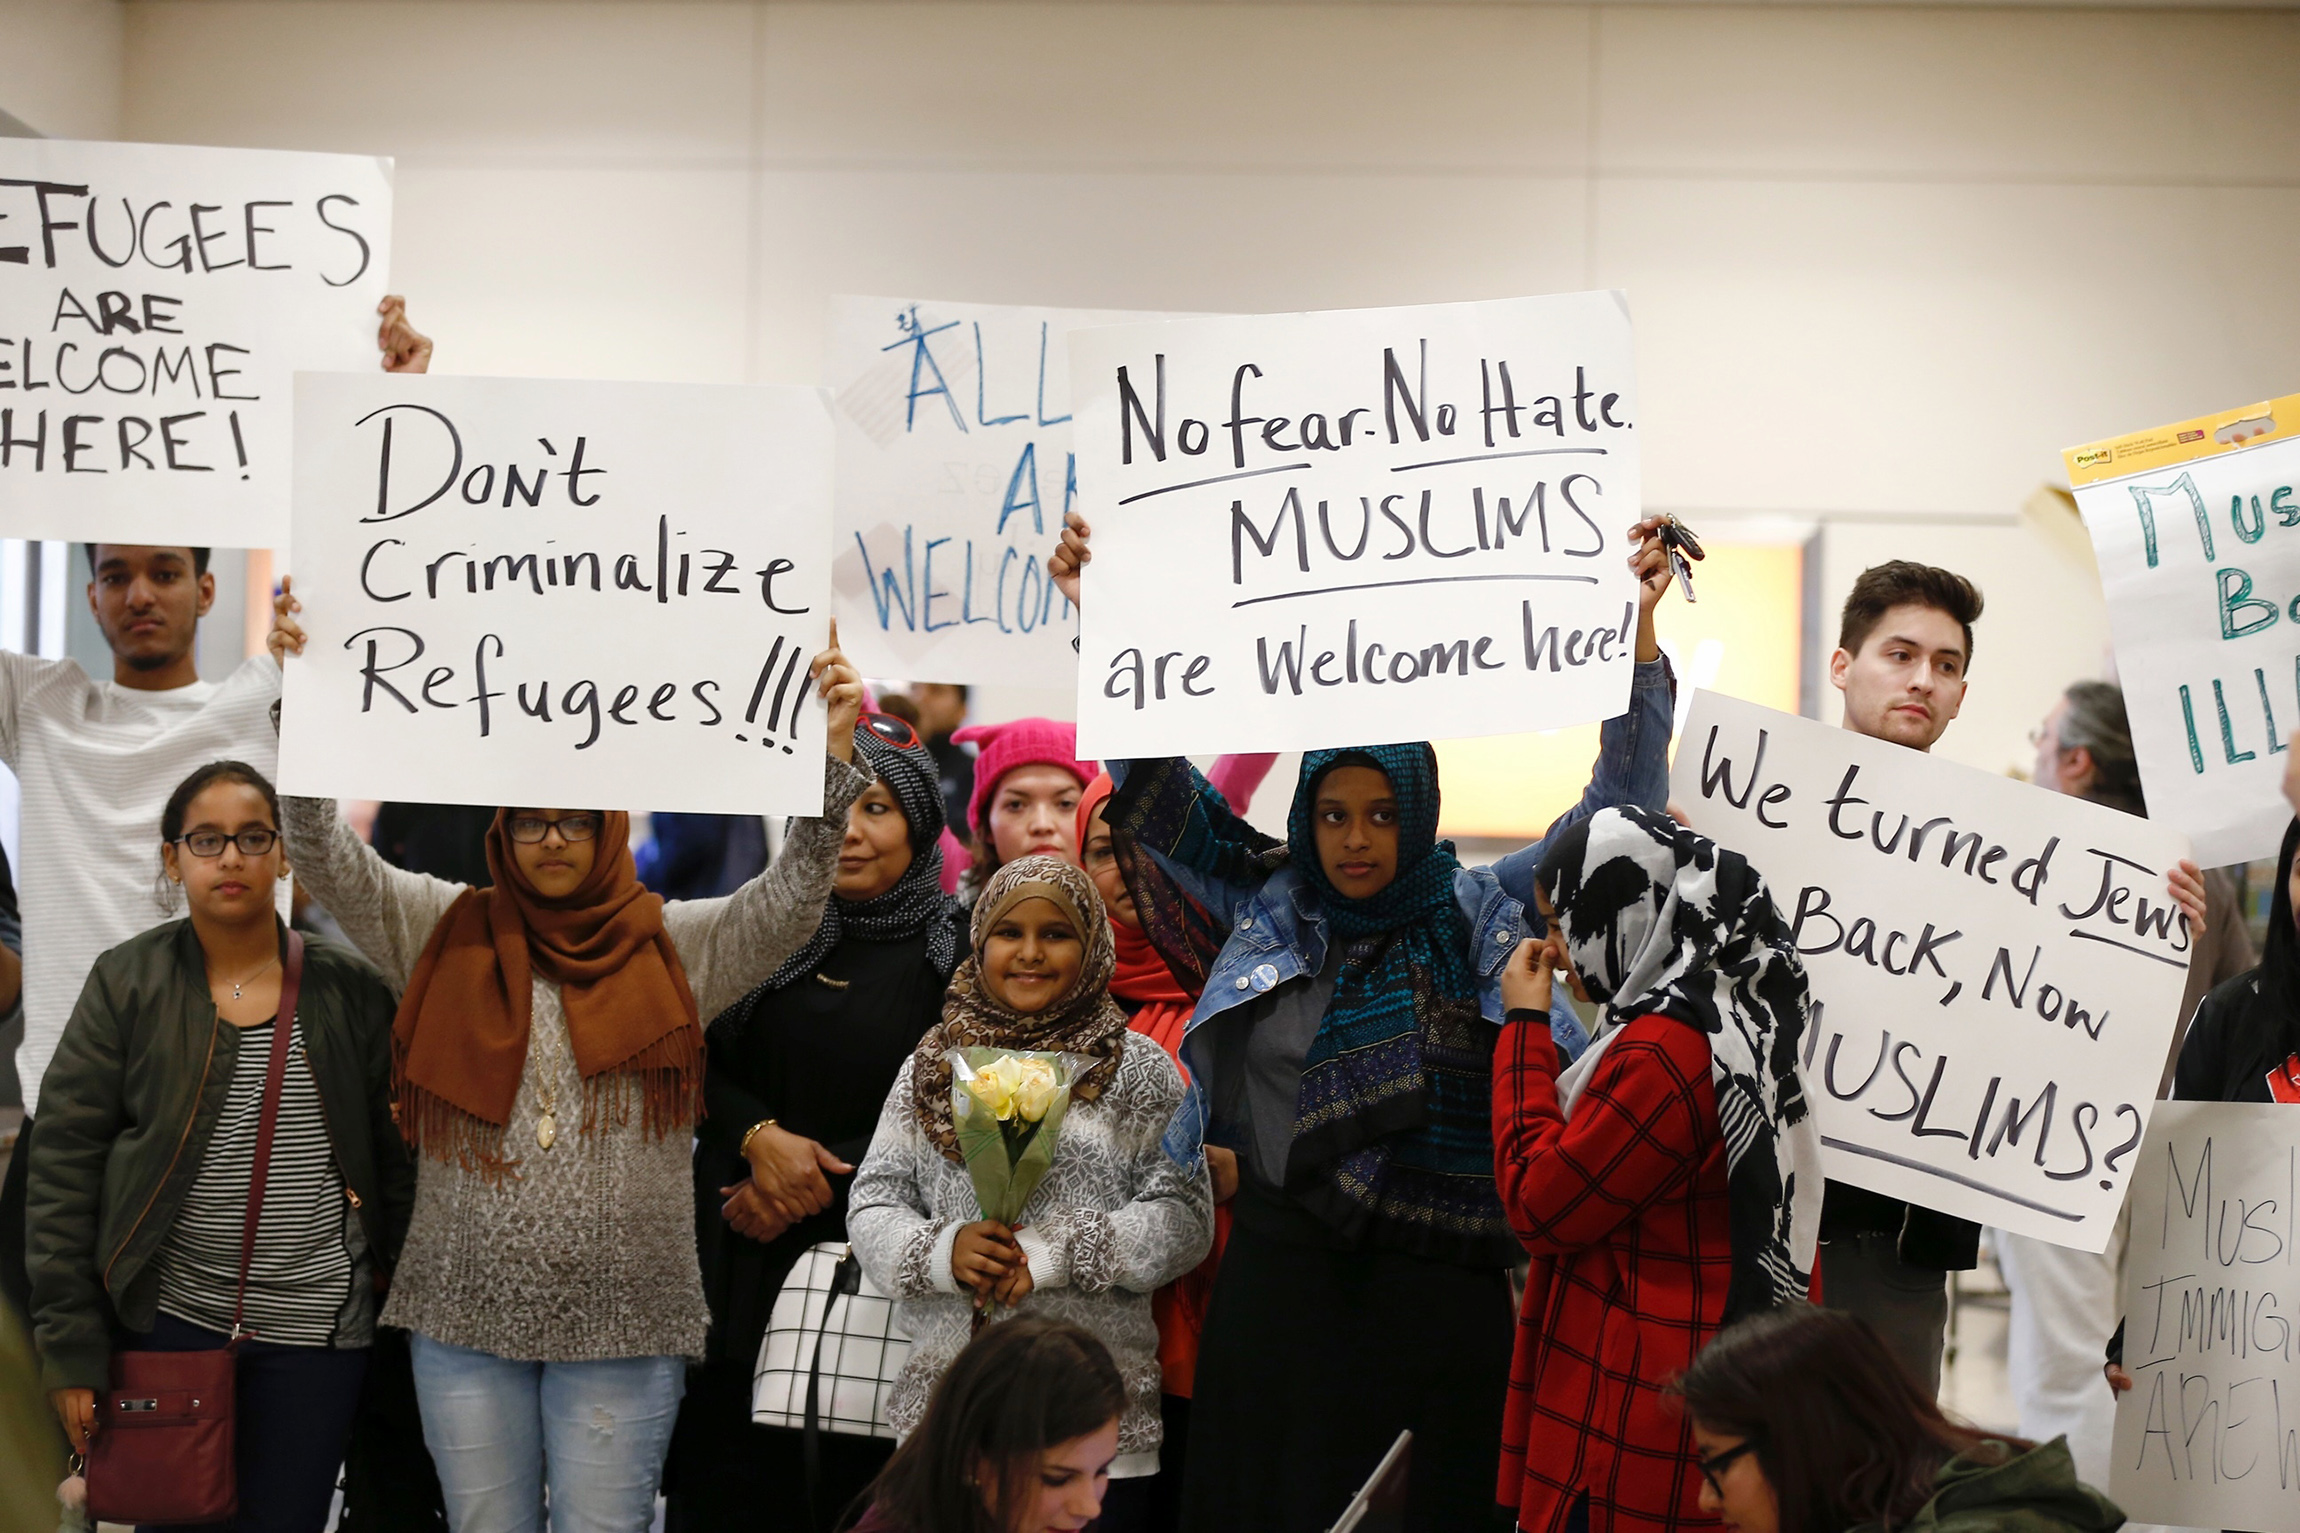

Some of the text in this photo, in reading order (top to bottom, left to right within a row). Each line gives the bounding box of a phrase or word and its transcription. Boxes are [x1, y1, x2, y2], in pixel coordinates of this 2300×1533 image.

[51, 287, 184, 336] ARE
[882, 310, 1073, 434] ALL
[1117, 353, 1210, 466] No
[1383, 338, 1457, 445] No
[1479, 358, 1634, 448] Hate.
[0, 408, 250, 481] HERE!
[2077, 449, 2108, 463] Post-it
[359, 514, 810, 614] Criminalize
[856, 523, 1070, 634] WELCO
[1232, 474, 1606, 584] MUSLIMS
[343, 626, 815, 755] Refugees!!!
[1103, 648, 1215, 711] are
[1256, 619, 1506, 696] Welcome
[1522, 600, 1634, 673] here!
[2179, 655, 2300, 775] ILL
[1701, 725, 2190, 953] We turned Jews
[1982, 945, 2110, 1041] Now
[2137, 1274, 2300, 1369] IMMIG
